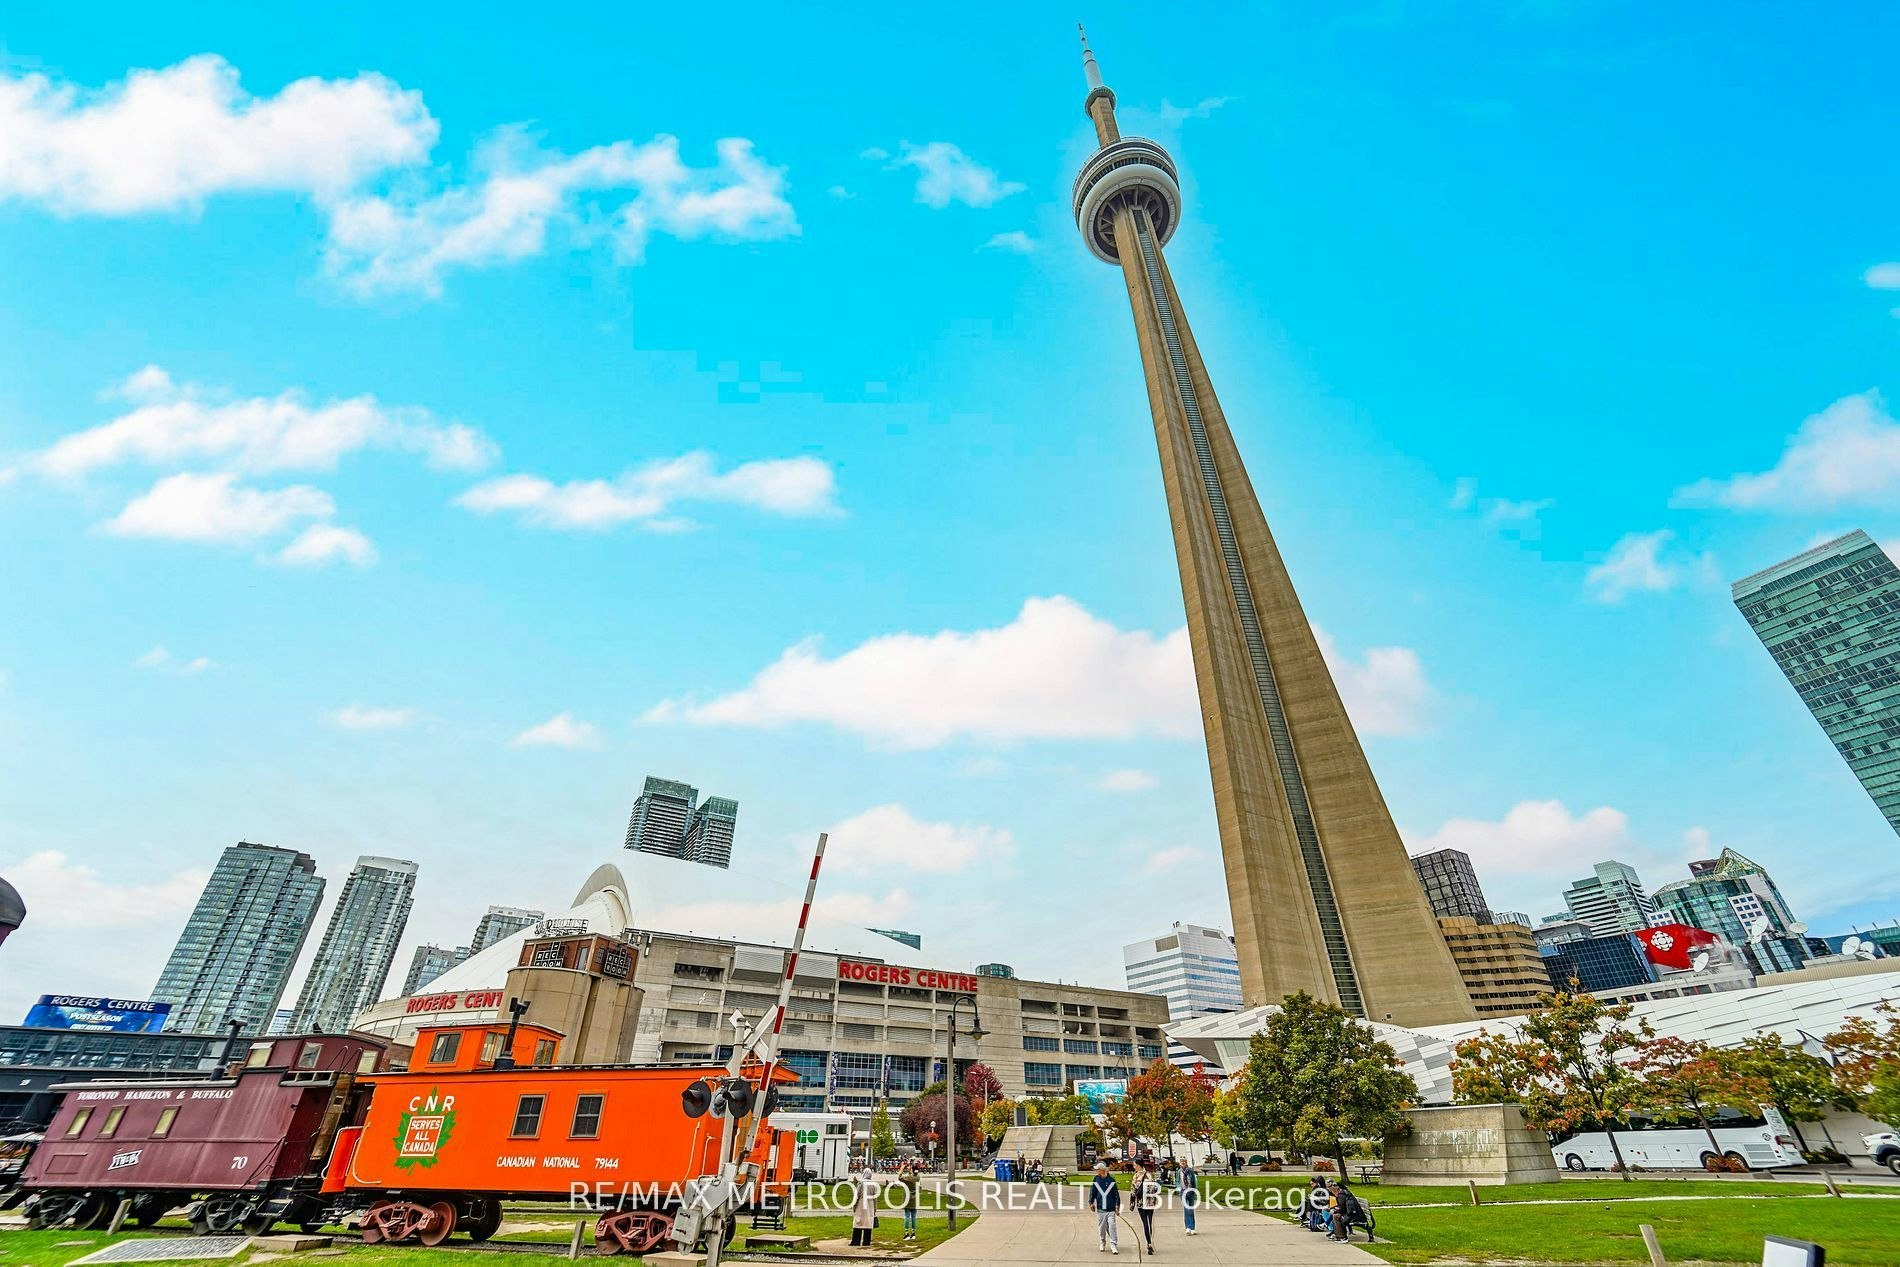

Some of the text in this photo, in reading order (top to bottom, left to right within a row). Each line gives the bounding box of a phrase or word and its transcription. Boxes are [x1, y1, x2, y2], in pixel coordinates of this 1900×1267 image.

[537, 952, 557, 960] REC
[838, 961, 978, 992] ROGERS CENTRE
[50, 995, 156, 1011] ROGERS CENTRE
[406, 991, 504, 1014] ROGERS CENT
[76, 1089, 234, 1100] TORONTO HAMILTON & BUFFALO
[410, 1119, 441, 1130] SERVES
[414, 1131, 430, 1141] ALL
[403, 1142, 435, 1153] CANADA
[231, 1156, 248, 1170] 70
[496, 1156, 620, 1169] CANADIAN NATIONAL 79144
